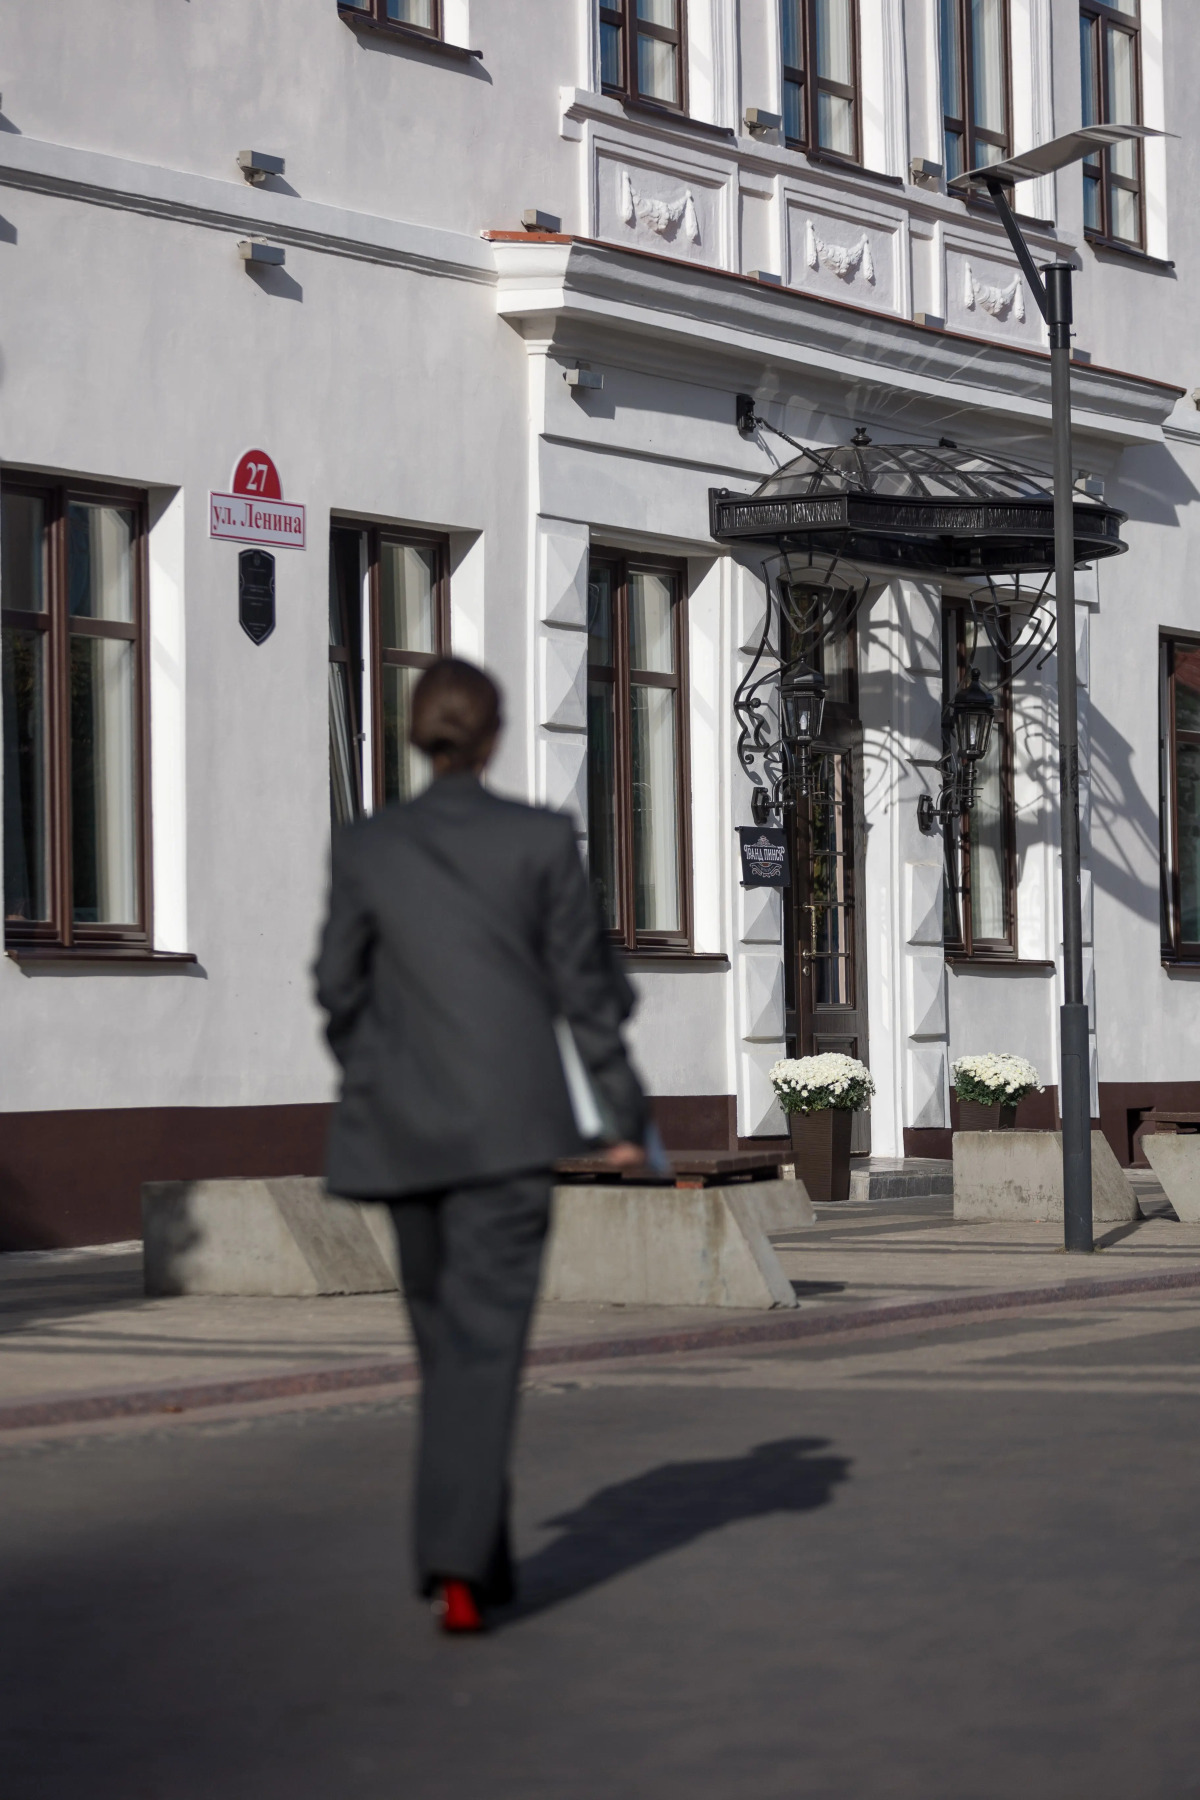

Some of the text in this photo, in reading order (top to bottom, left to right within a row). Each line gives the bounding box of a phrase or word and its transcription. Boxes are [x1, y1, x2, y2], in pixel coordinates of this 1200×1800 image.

[245, 461, 268, 492] 27
[213, 503, 302, 534] ул. Ленина
[763, 845, 786, 862] ПИНСК
